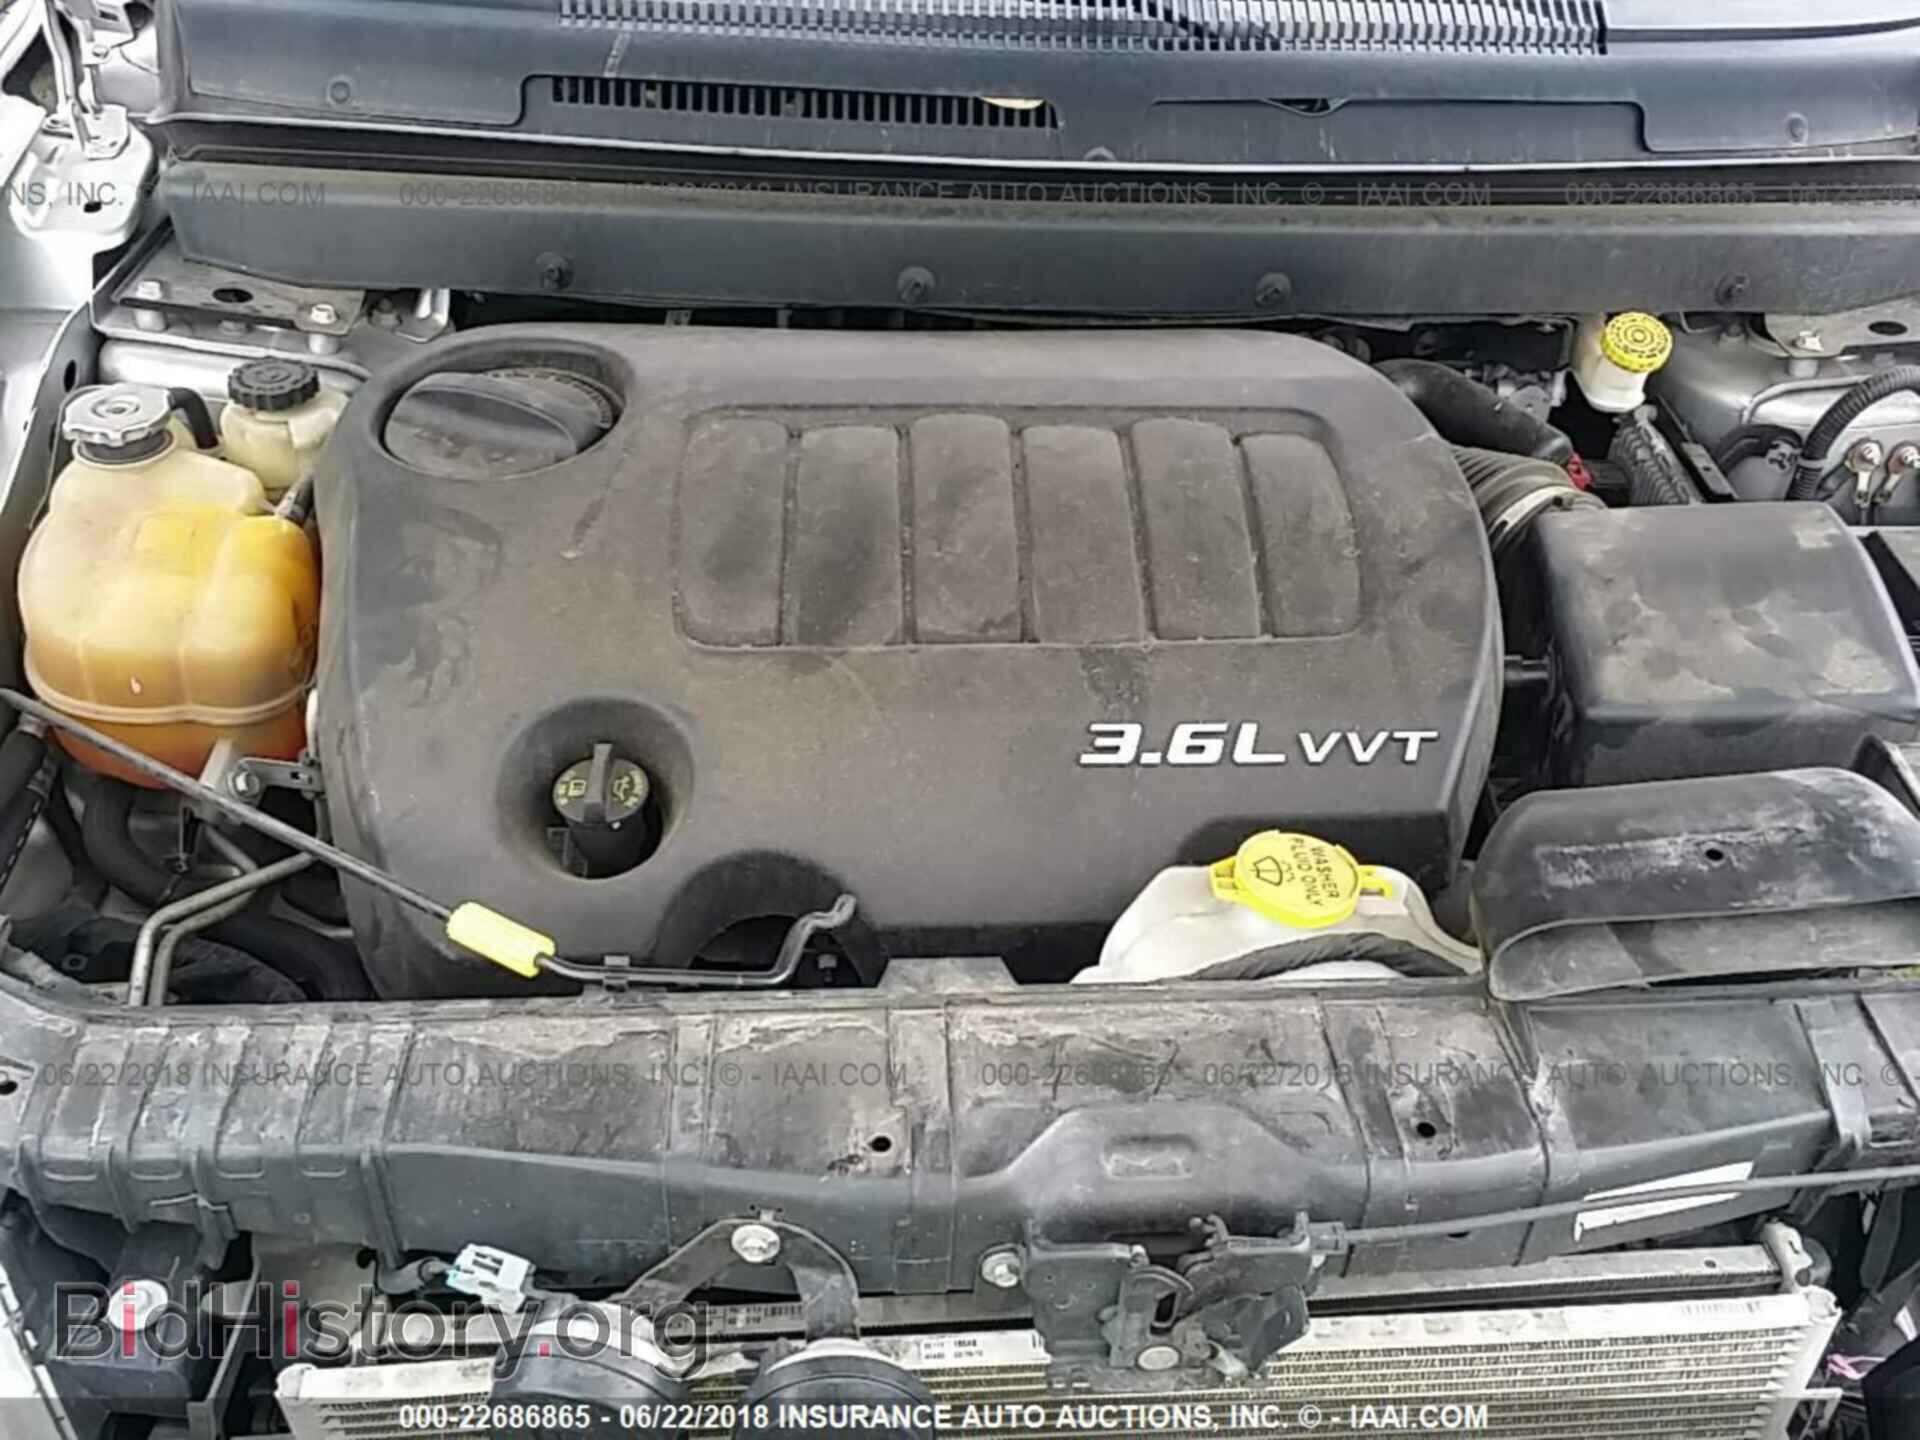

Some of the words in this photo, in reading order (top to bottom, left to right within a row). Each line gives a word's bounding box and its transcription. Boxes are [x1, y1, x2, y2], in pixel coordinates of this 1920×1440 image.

[1079, 722, 1287, 765] 3.6L
[1298, 730, 1439, 764] VVT
[1290, 837, 1313, 873] FLUID
[1311, 844, 1340, 899] WASHER
[1300, 874, 1324, 907] ONLY
